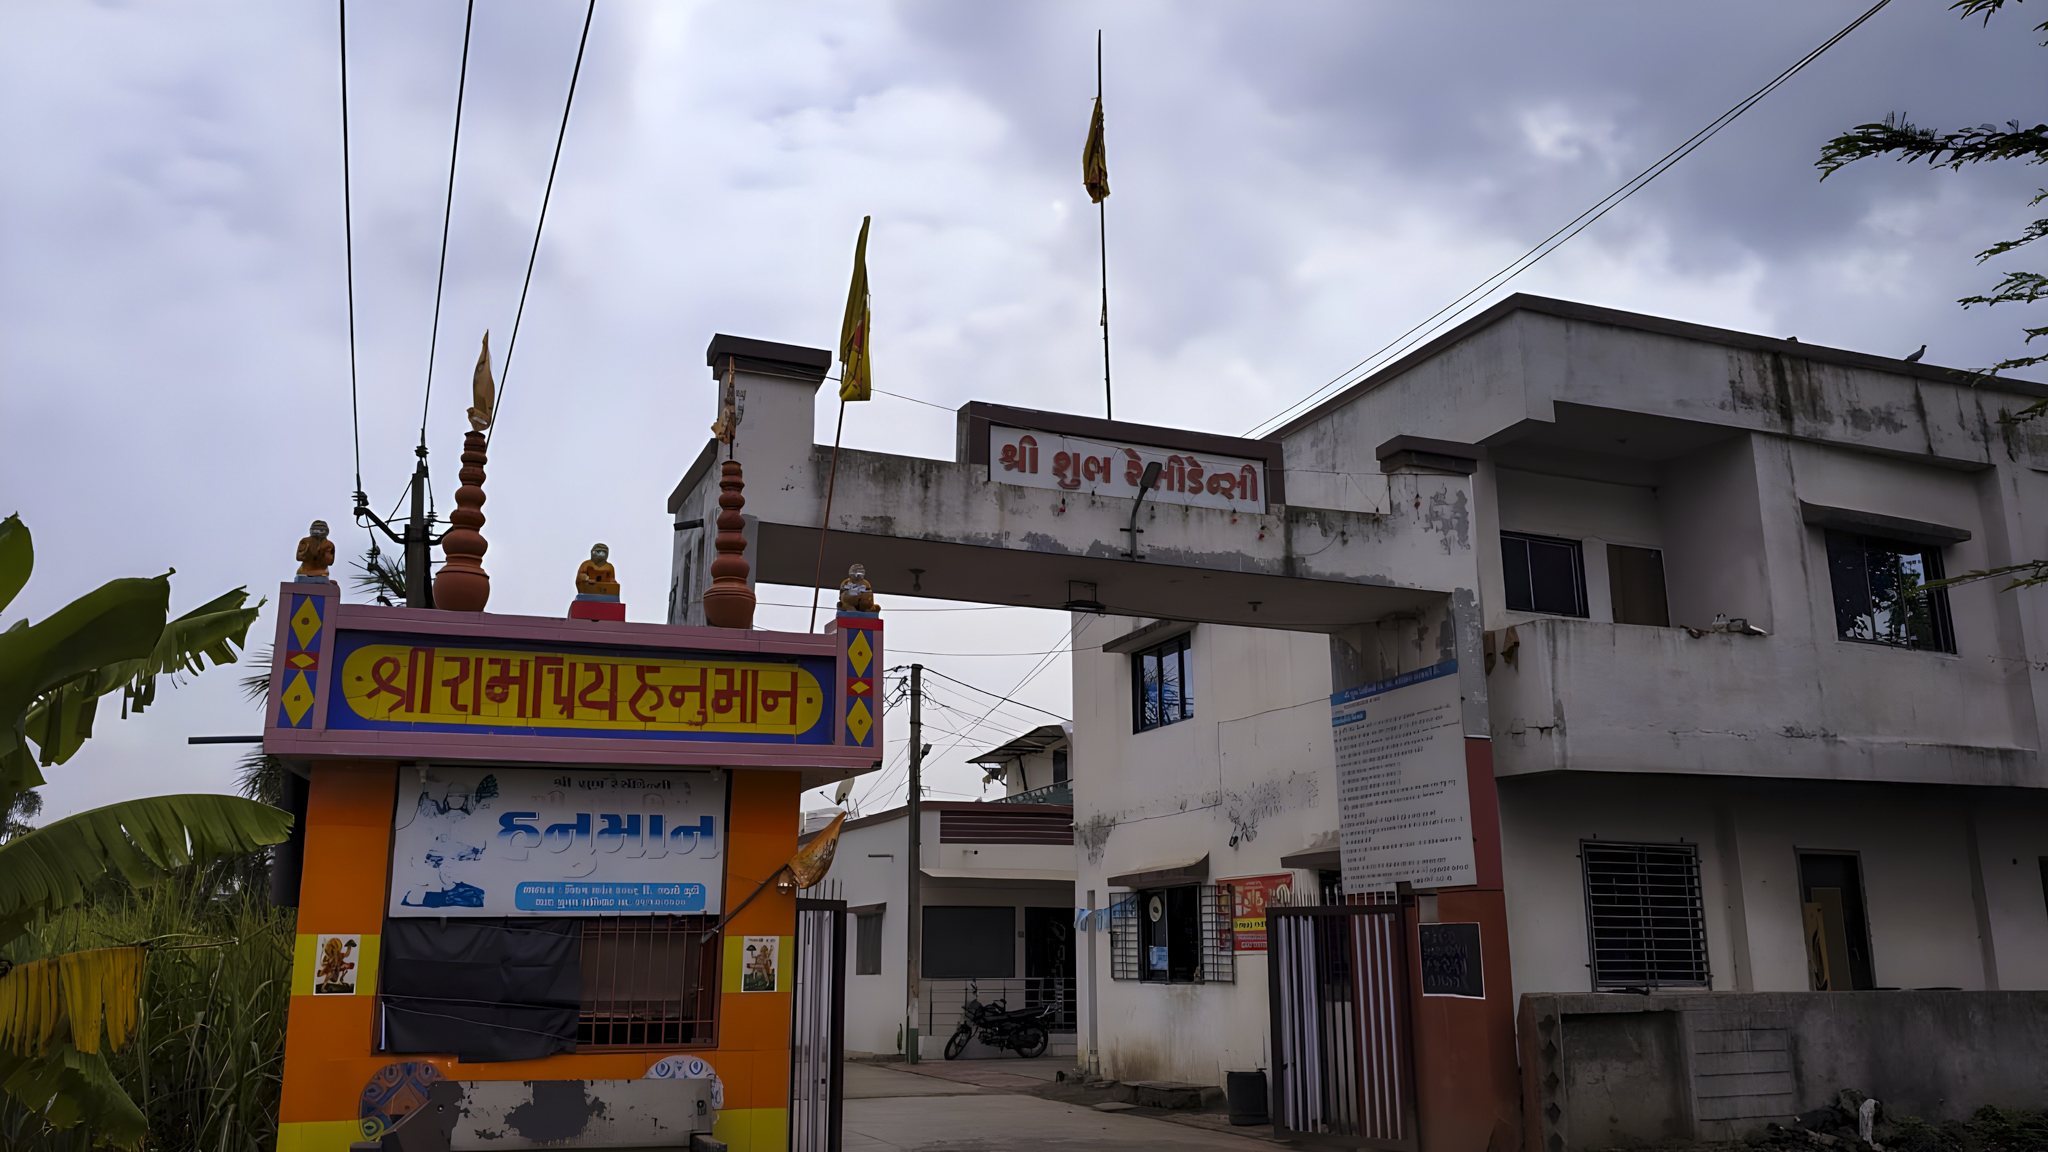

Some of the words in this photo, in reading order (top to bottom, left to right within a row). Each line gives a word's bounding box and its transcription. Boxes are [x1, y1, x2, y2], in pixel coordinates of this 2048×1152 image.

[998, 435, 1039, 475] શ્રી
[1052, 451, 1111, 490] શુભ
[497, 811, 719, 879] હનુમાન
